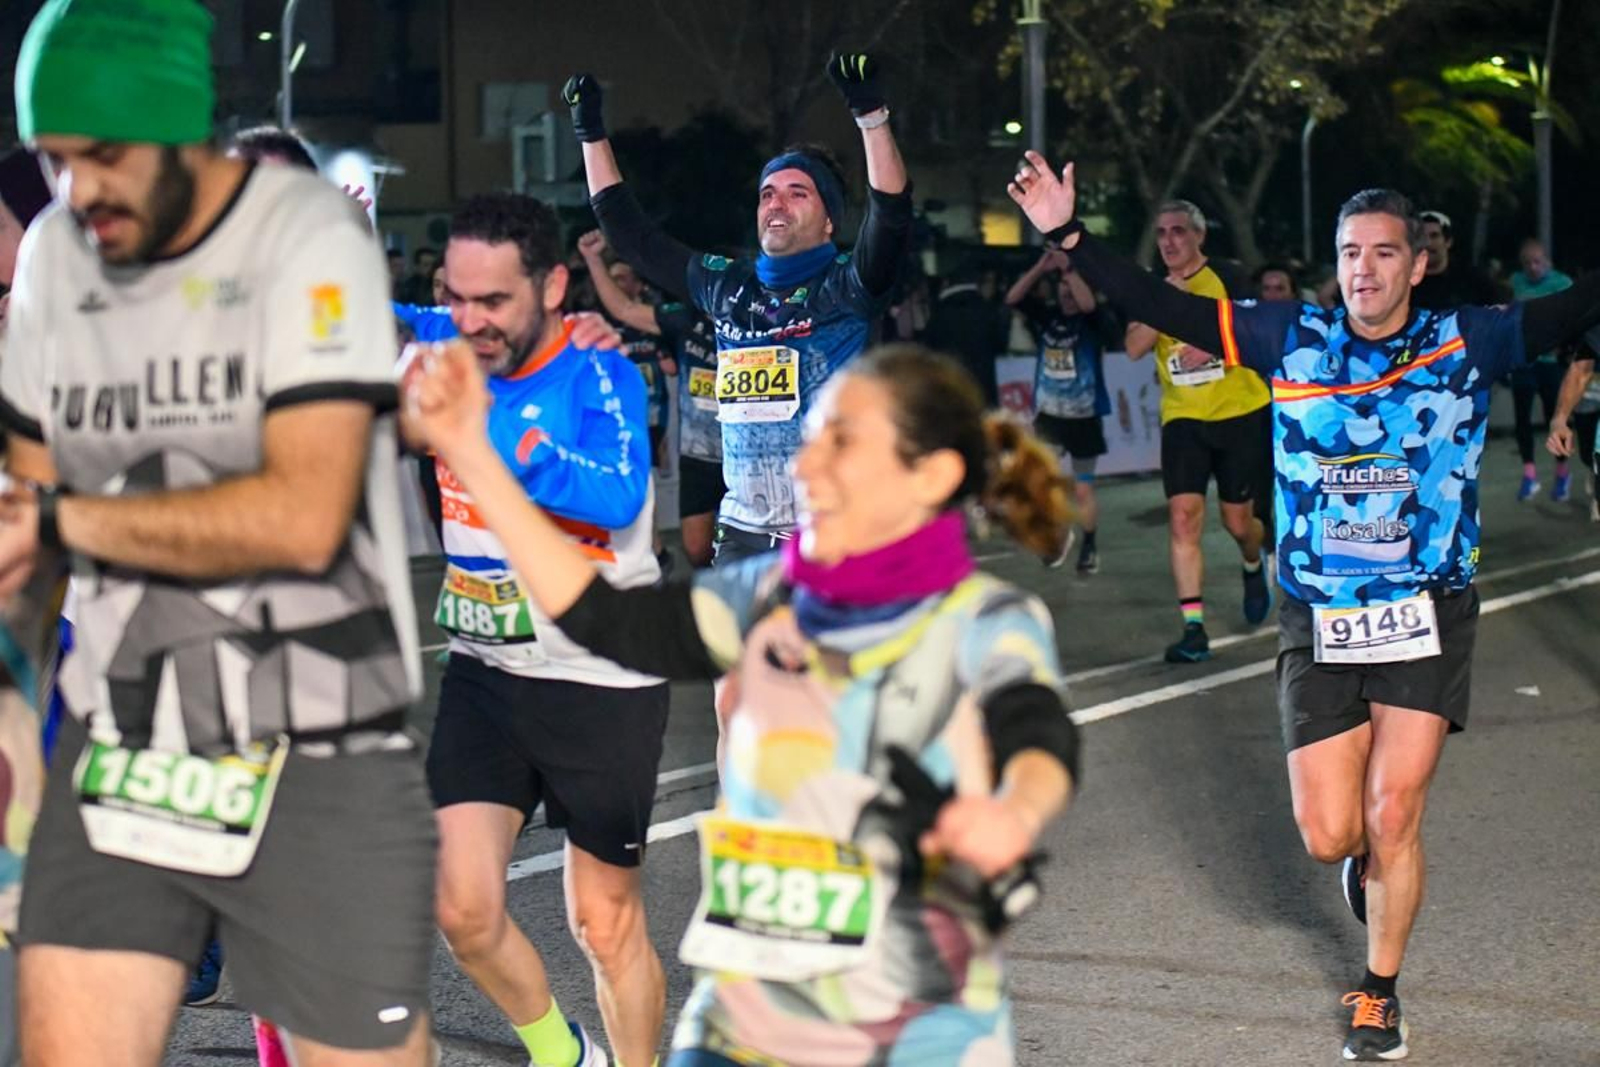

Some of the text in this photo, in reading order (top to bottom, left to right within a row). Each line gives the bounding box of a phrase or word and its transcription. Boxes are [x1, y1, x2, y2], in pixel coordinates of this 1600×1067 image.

[690, 379, 717, 397] 39
[722, 367, 790, 395] 3804
[1322, 516, 1410, 540] Rosales
[443, 593, 521, 637] 1887
[1331, 603, 1421, 642] 9148
[97, 747, 257, 823] 1506
[716, 860, 864, 930] 1287
